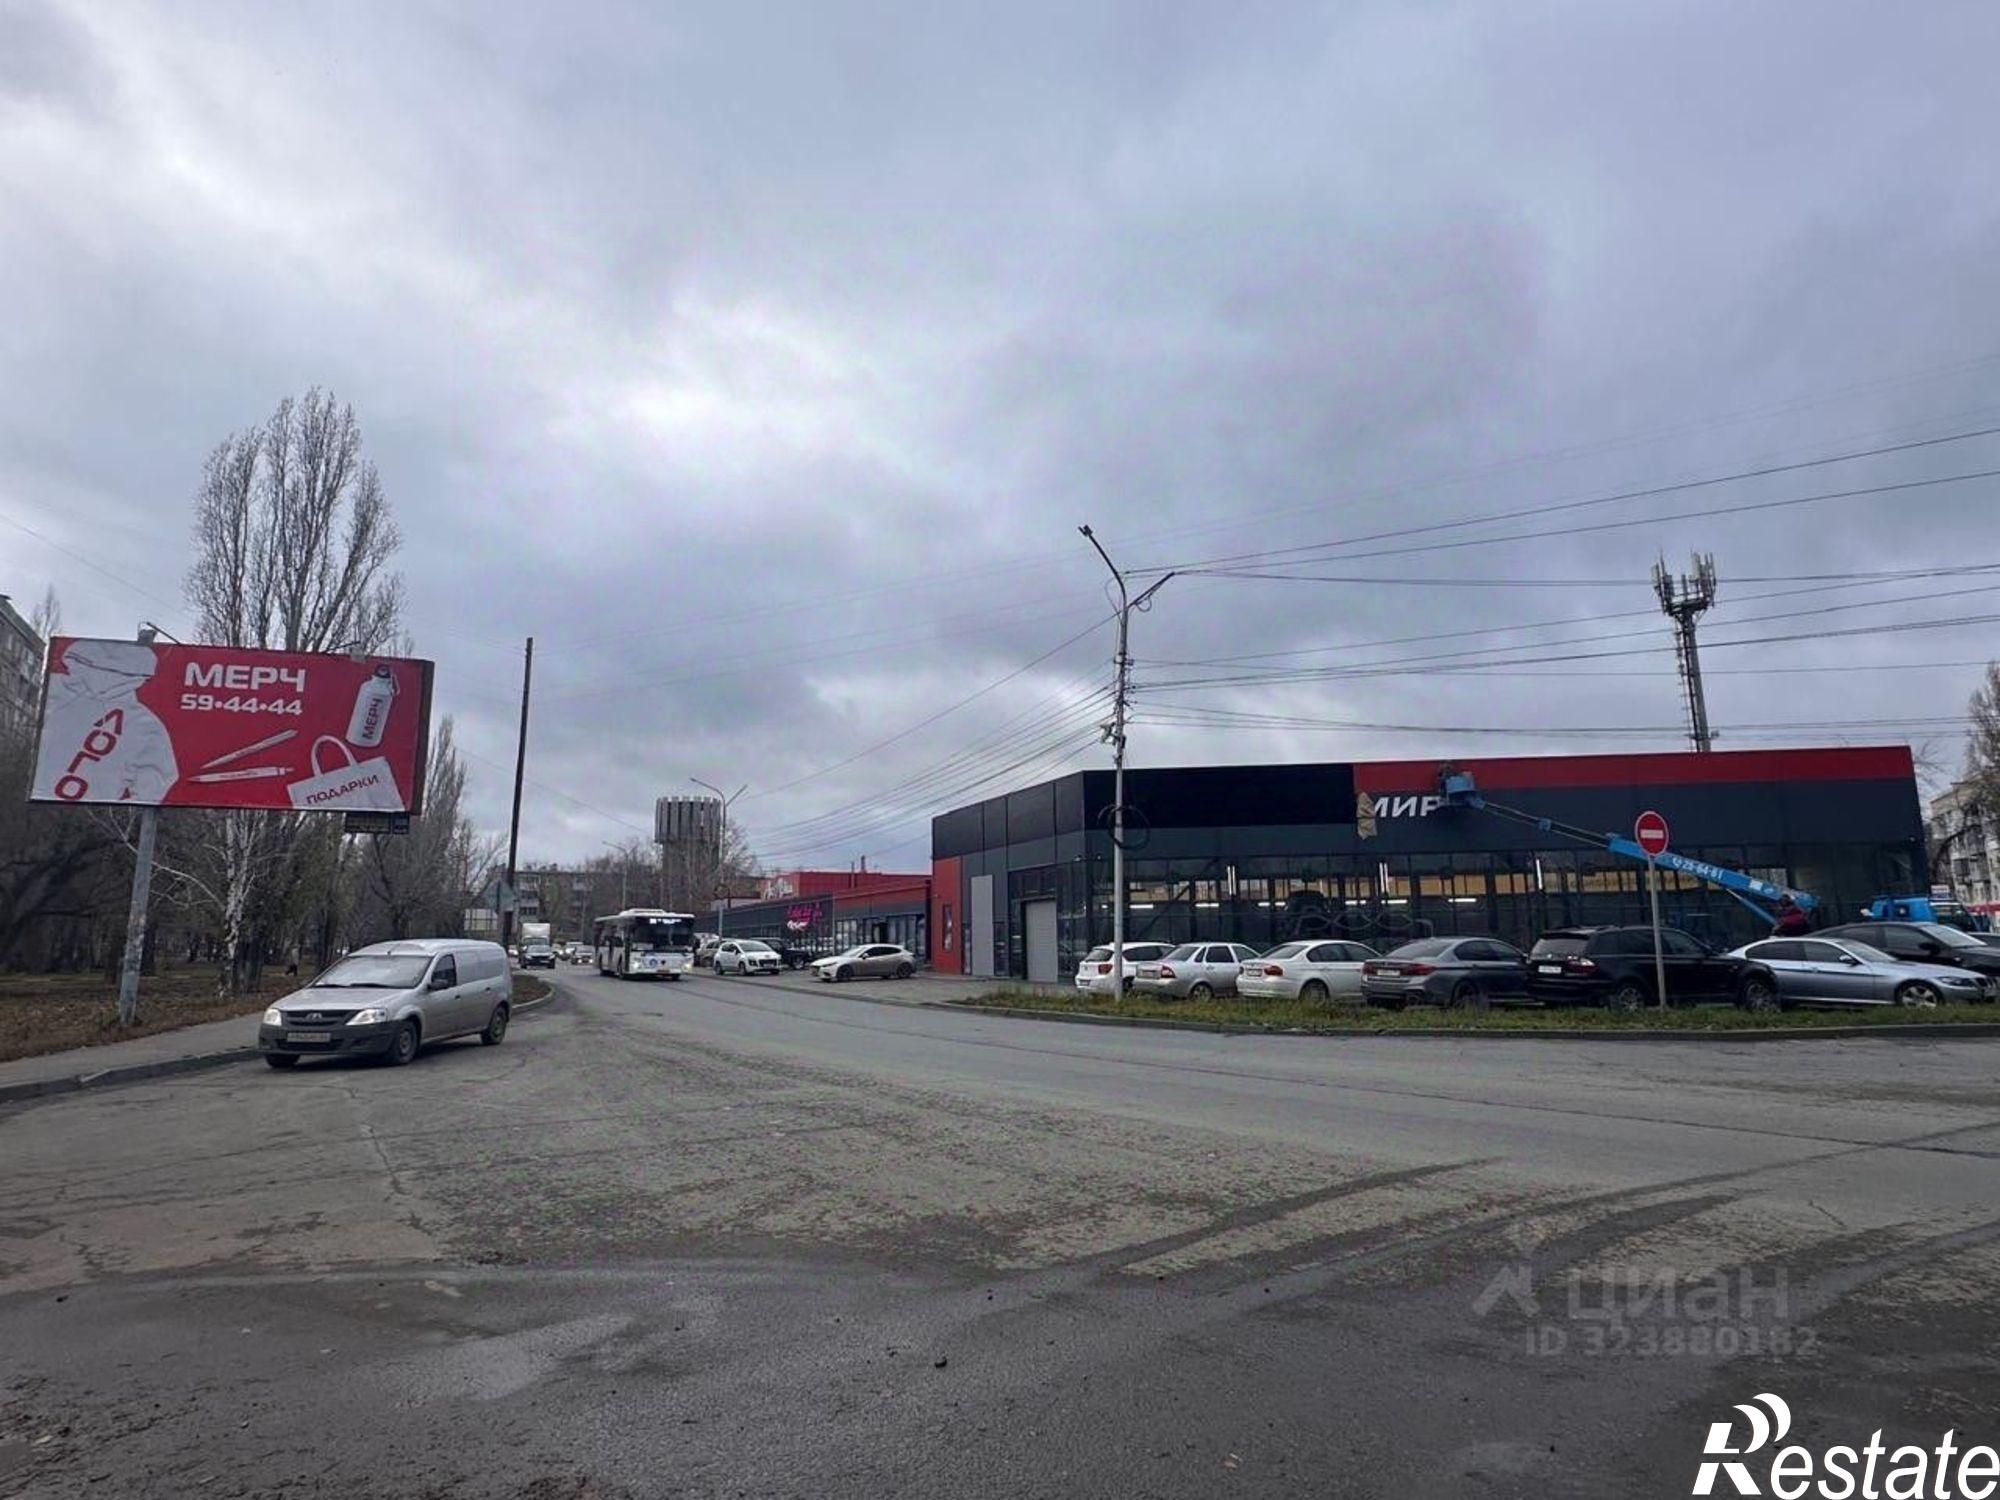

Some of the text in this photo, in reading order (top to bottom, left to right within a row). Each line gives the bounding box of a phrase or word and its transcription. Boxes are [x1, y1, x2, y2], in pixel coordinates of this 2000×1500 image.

[184, 661, 306, 693] МЕРЧ
[54, 707, 124, 801] ЛОГО
[305, 774, 380, 805] ПОДАРКИ
